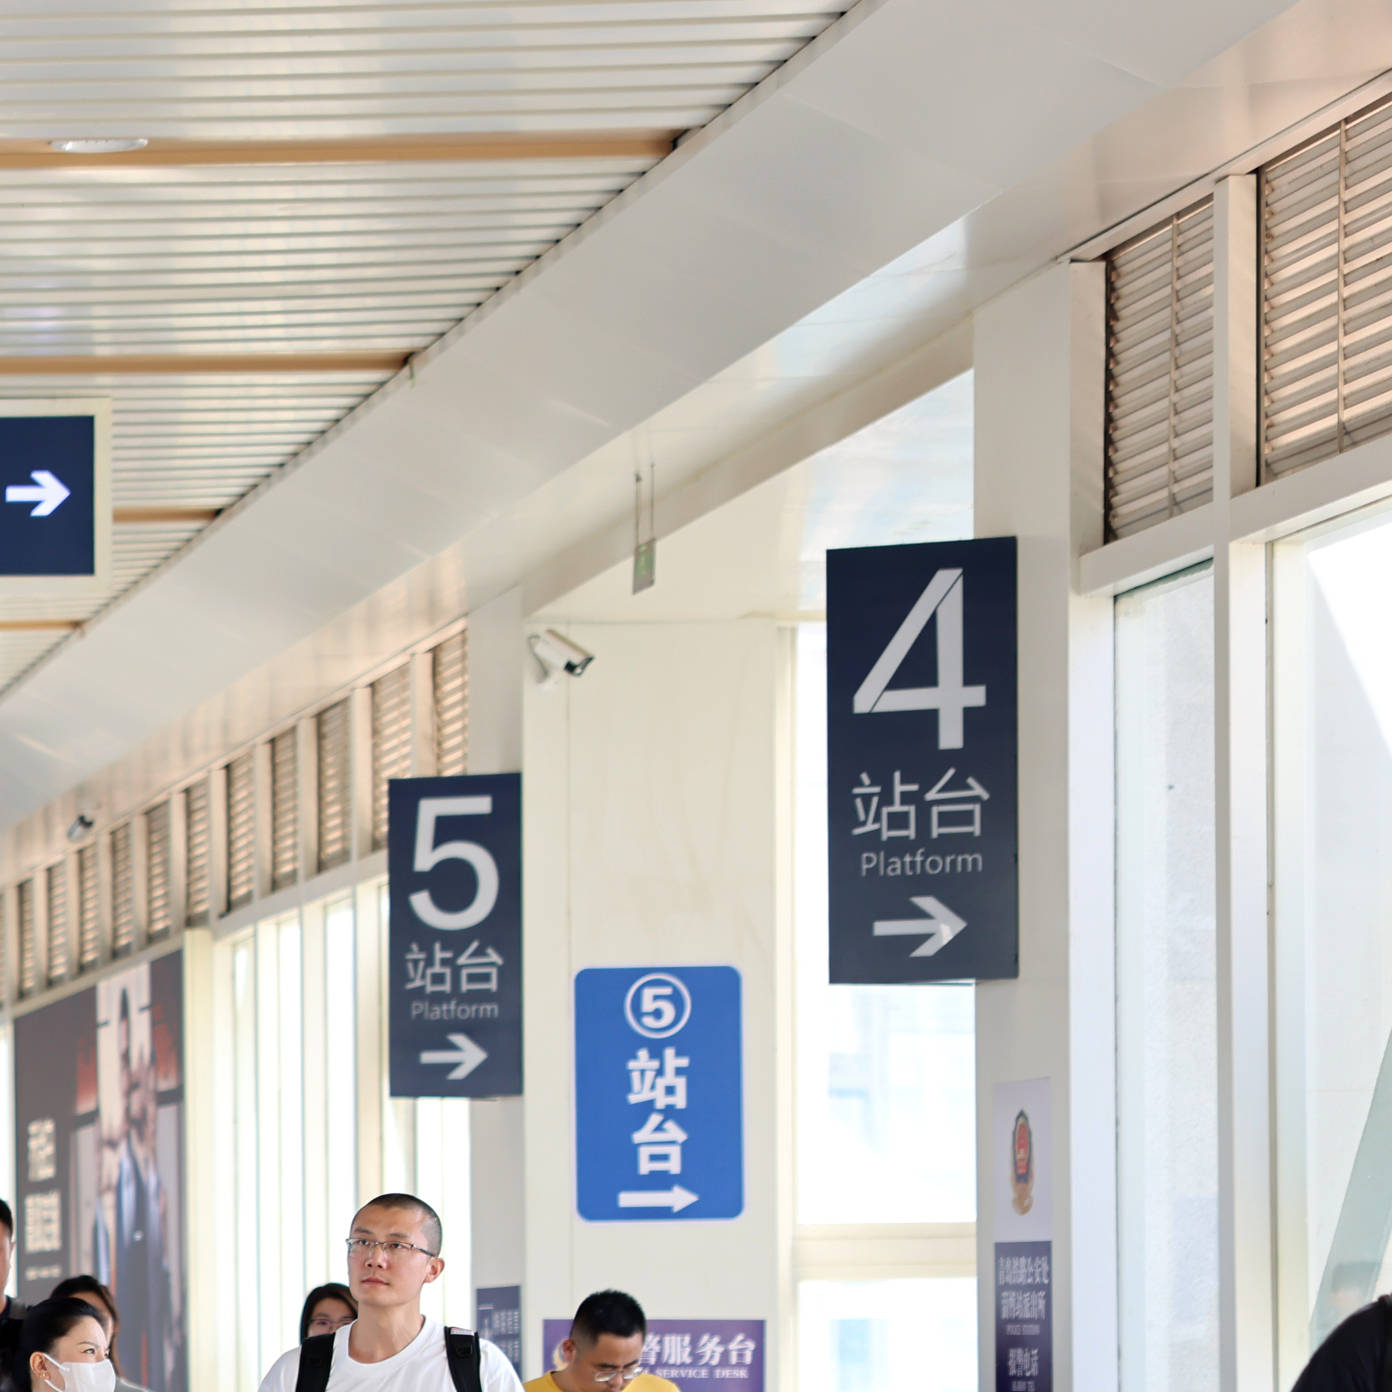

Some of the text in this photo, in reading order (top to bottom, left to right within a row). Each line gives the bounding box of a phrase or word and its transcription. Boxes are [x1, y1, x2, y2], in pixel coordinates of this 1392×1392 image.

[852, 568, 987, 750] 4
[851, 767, 991, 841] 站台
[408, 795, 500, 932] 5
[860, 847, 983, 878] Platform
[405, 940, 504, 994] 站台
[411, 999, 499, 1021] Platform
[627, 1048, 690, 1175] 站台
[655, 1367, 749, 1379] SERVICE DESK
